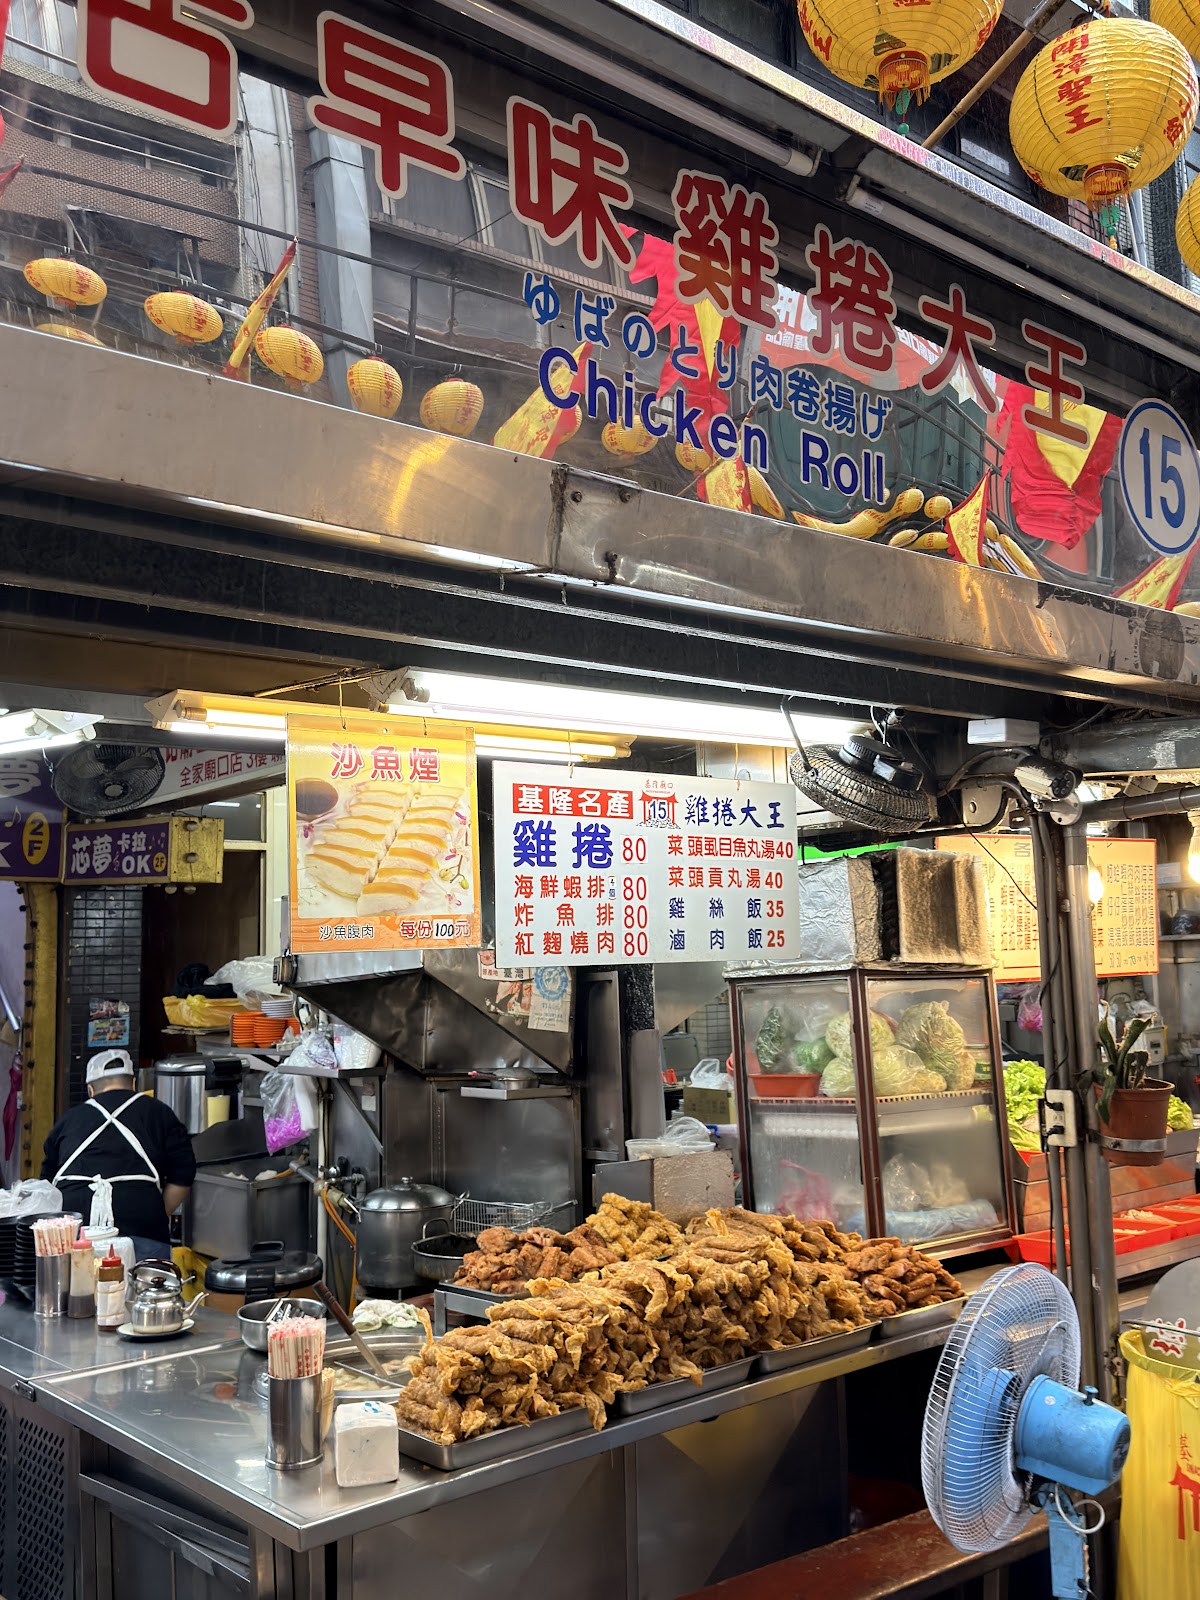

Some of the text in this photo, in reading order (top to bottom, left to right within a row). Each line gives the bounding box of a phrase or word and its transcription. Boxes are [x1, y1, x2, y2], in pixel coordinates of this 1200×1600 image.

[541, 349, 767, 470] Chicken
[802, 432, 884, 501] Roll
[1139, 427, 1184, 529] 15
[331, 741, 439, 782] 沙魚煙
[518, 785, 630, 817] 基隆名產
[650, 800, 667, 819] 15
[685, 795, 785, 829] 雞捲大王
[71, 834, 112, 874] 芯夢
[513, 820, 646, 868] 雞捲 80
[776, 842, 793, 859] 40
[122, 855, 151, 874] OK
[668, 866, 783, 889] 菜頭貢丸湯 40
[514, 874, 605, 899] 海鮮蝦排
[623, 877, 647, 900] 80
[514, 902, 648, 929] 炸魚排 80
[669, 897, 784, 919] 雞絲飯 35
[320, 924, 374, 939] 沙魚腹肉
[624, 931, 648, 956] 80
[669, 929, 785, 951] 滷肉飯 25
